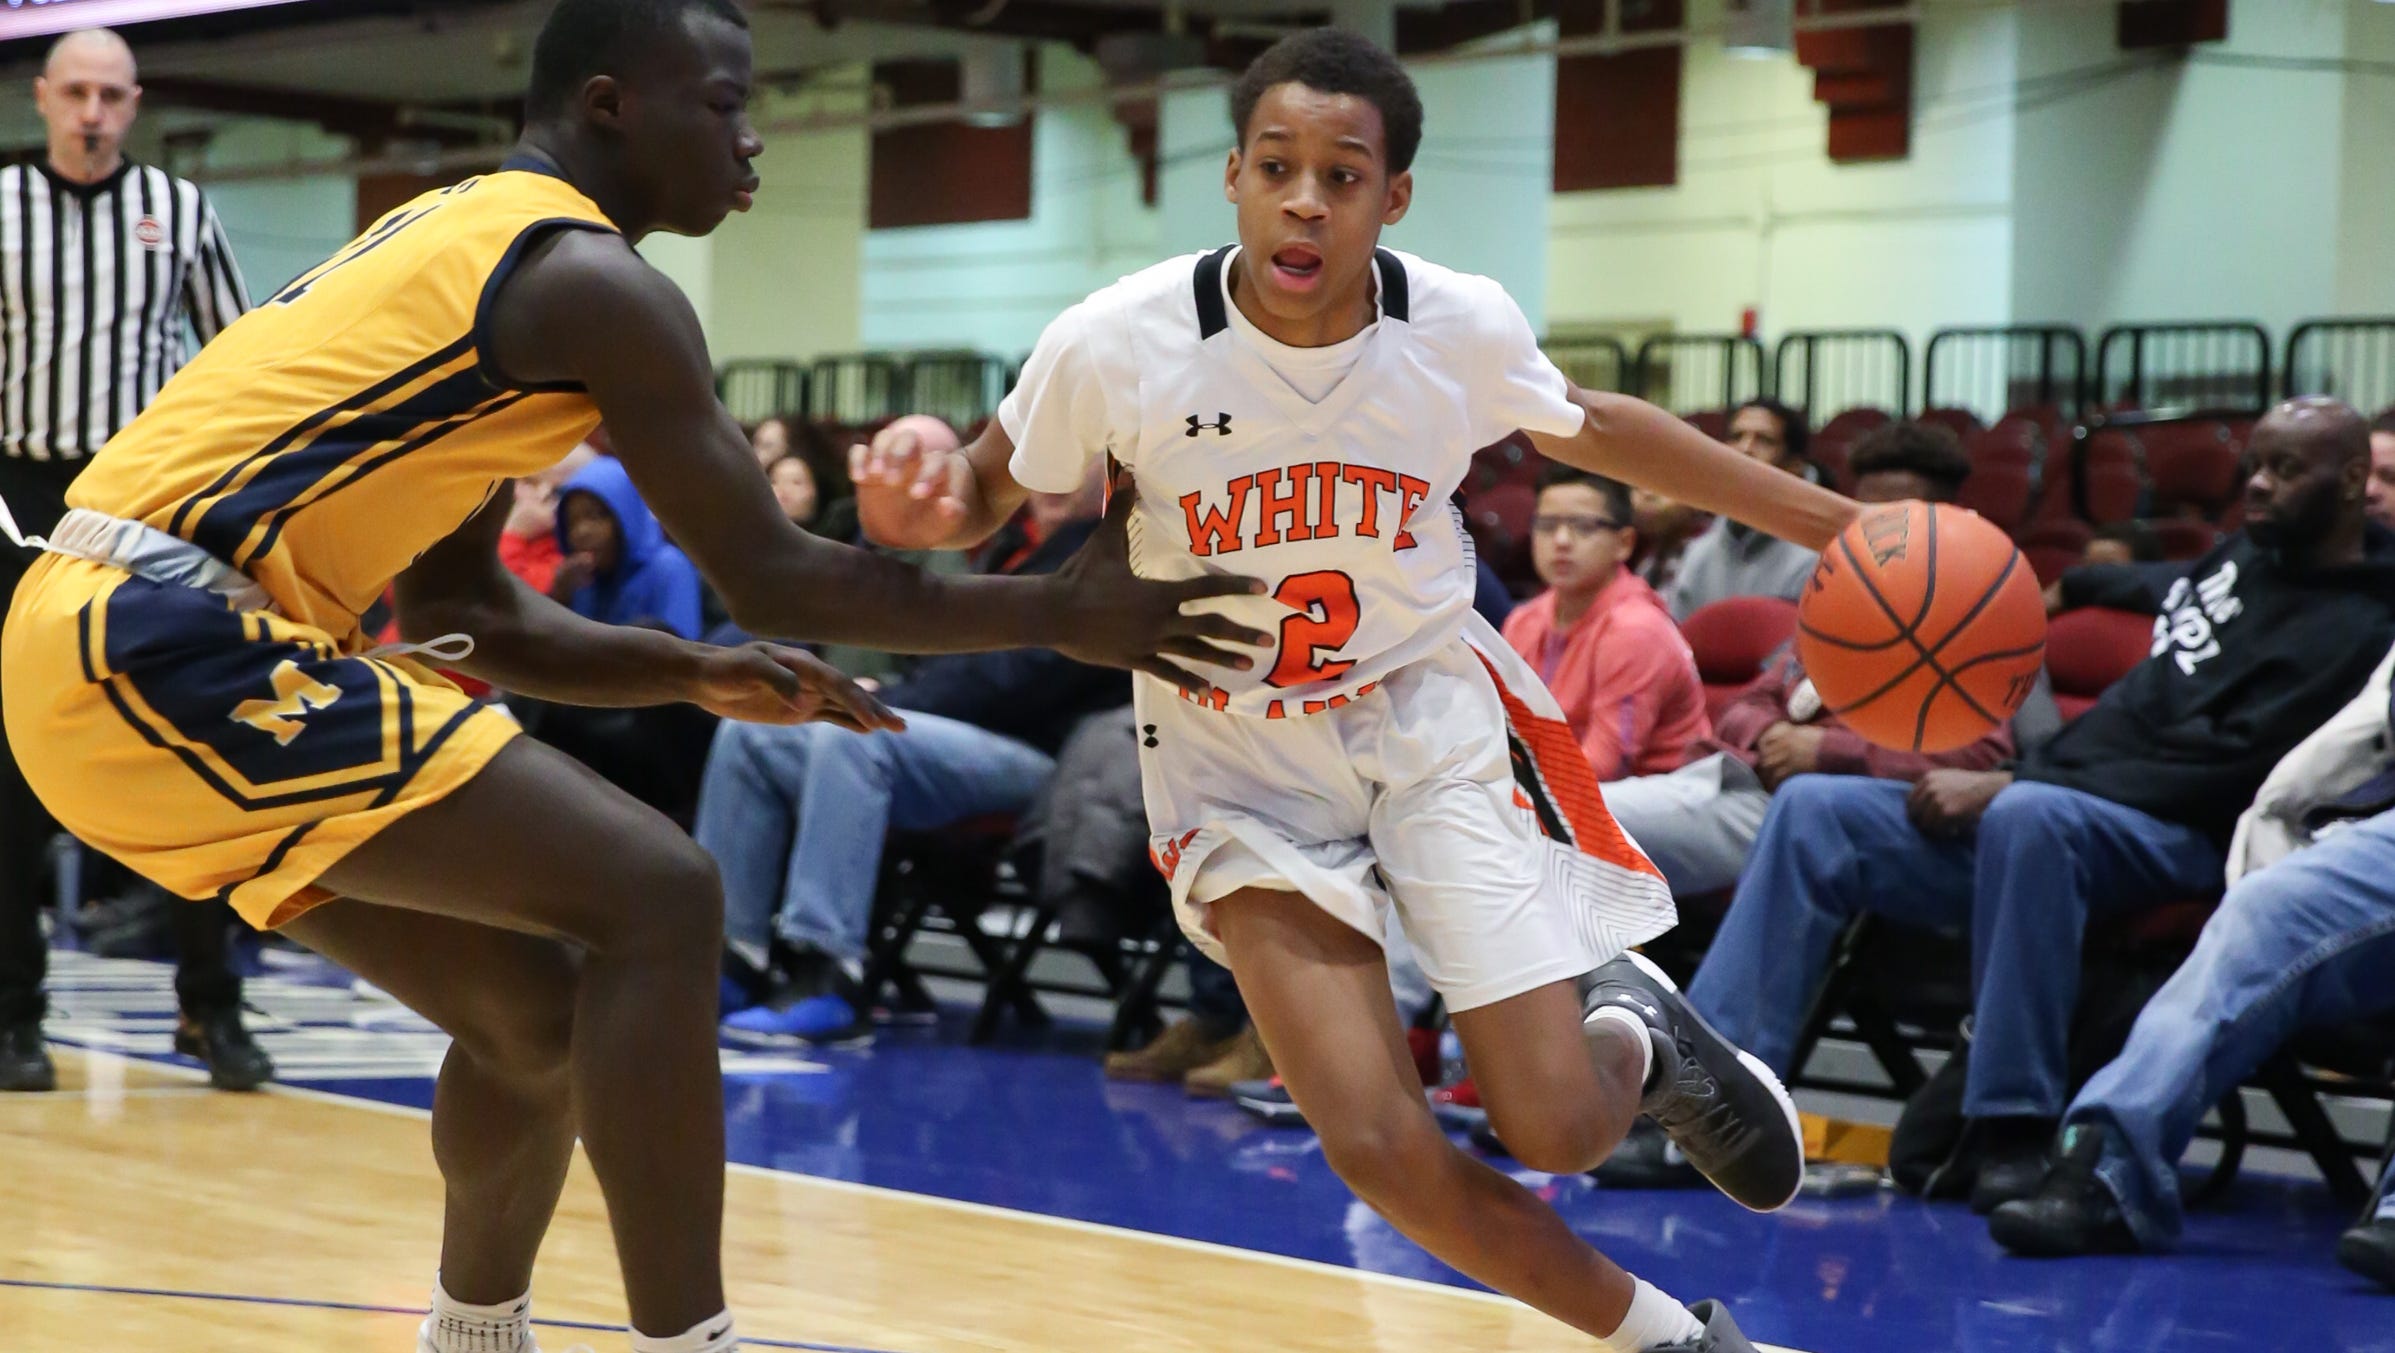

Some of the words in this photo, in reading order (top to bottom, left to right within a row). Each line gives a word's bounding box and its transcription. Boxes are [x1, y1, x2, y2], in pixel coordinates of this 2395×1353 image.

[1179, 461, 1431, 557] WHITE
[1262, 569, 1361, 689] 2
[226, 659, 344, 747] M
